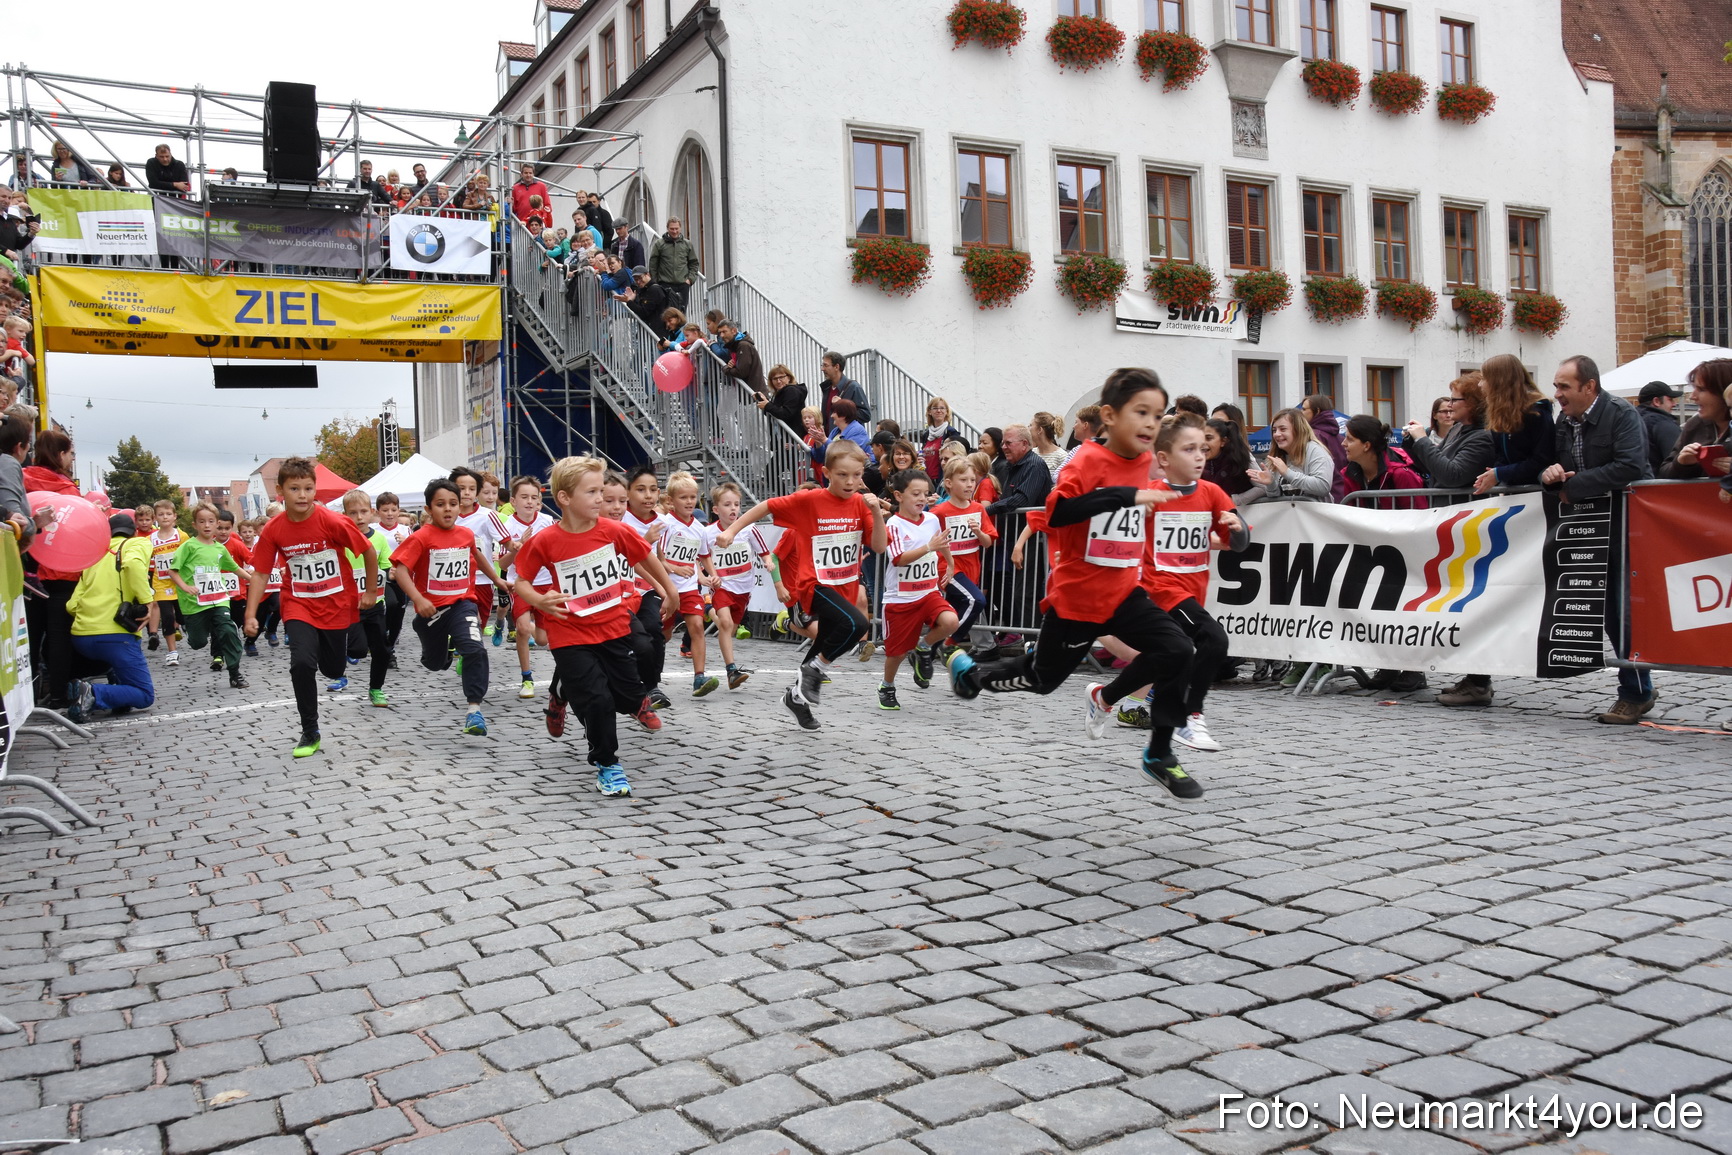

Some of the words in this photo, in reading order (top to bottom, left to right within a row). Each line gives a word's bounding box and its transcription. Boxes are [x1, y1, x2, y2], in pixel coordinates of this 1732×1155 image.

[161, 214, 240, 236] BOCK
[247, 222, 283, 233] OFFICE
[285, 225, 334, 236] INDUSTRY
[409, 224, 443, 240] BMW
[96, 232, 148, 241] NeuerMarkt
[267, 238, 358, 251] www.bockonline.de
[68, 299, 128, 311] Neumarkter
[130, 304, 176, 315] Stadtlauf
[234, 289, 337, 326] ZIEL
[1167, 302, 1219, 323] swn
[390, 314, 440, 323] Neumarkter
[442, 314, 480, 323] Stadtlauf
[71, 328, 125, 337] Neumarkter
[127, 330, 169, 340] Stadtlauf
[1165, 322, 1201, 331] stadtwerke
[1202, 324, 1233, 334] neumarkt
[360, 338, 406, 346] Neumarkter
[407, 339, 442, 347] Stadtlauf
[1573, 502, 1595, 511] Strom
[950, 524, 980, 540] 722
[1162, 526, 1208, 550] 7068
[1568, 527, 1596, 535] Erdgas
[672, 544, 698, 562] 7042
[716, 549, 749, 567] 7005
[818, 543, 858, 567] 7062
[1179, 555, 1197, 565] Paul
[1570, 552, 1595, 560] Wasser
[294, 559, 337, 581] 7150
[435, 559, 469, 579] 7423
[904, 560, 937, 580] 7020
[565, 559, 619, 596] 7154
[1217, 542, 1408, 612] swn
[1568, 578, 1593, 586] Wärme
[225, 579, 237, 590] 23
[912, 582, 931, 590] Ruben
[586, 592, 612, 606] Kilian
[1565, 603, 1591, 611] Freizeit
[1217, 611, 1333, 640] stadtwerke
[1340, 620, 1462, 649] neumarkt
[1555, 628, 1594, 638] Stadtbusse
[1552, 653, 1594, 664] Parkhäuser
